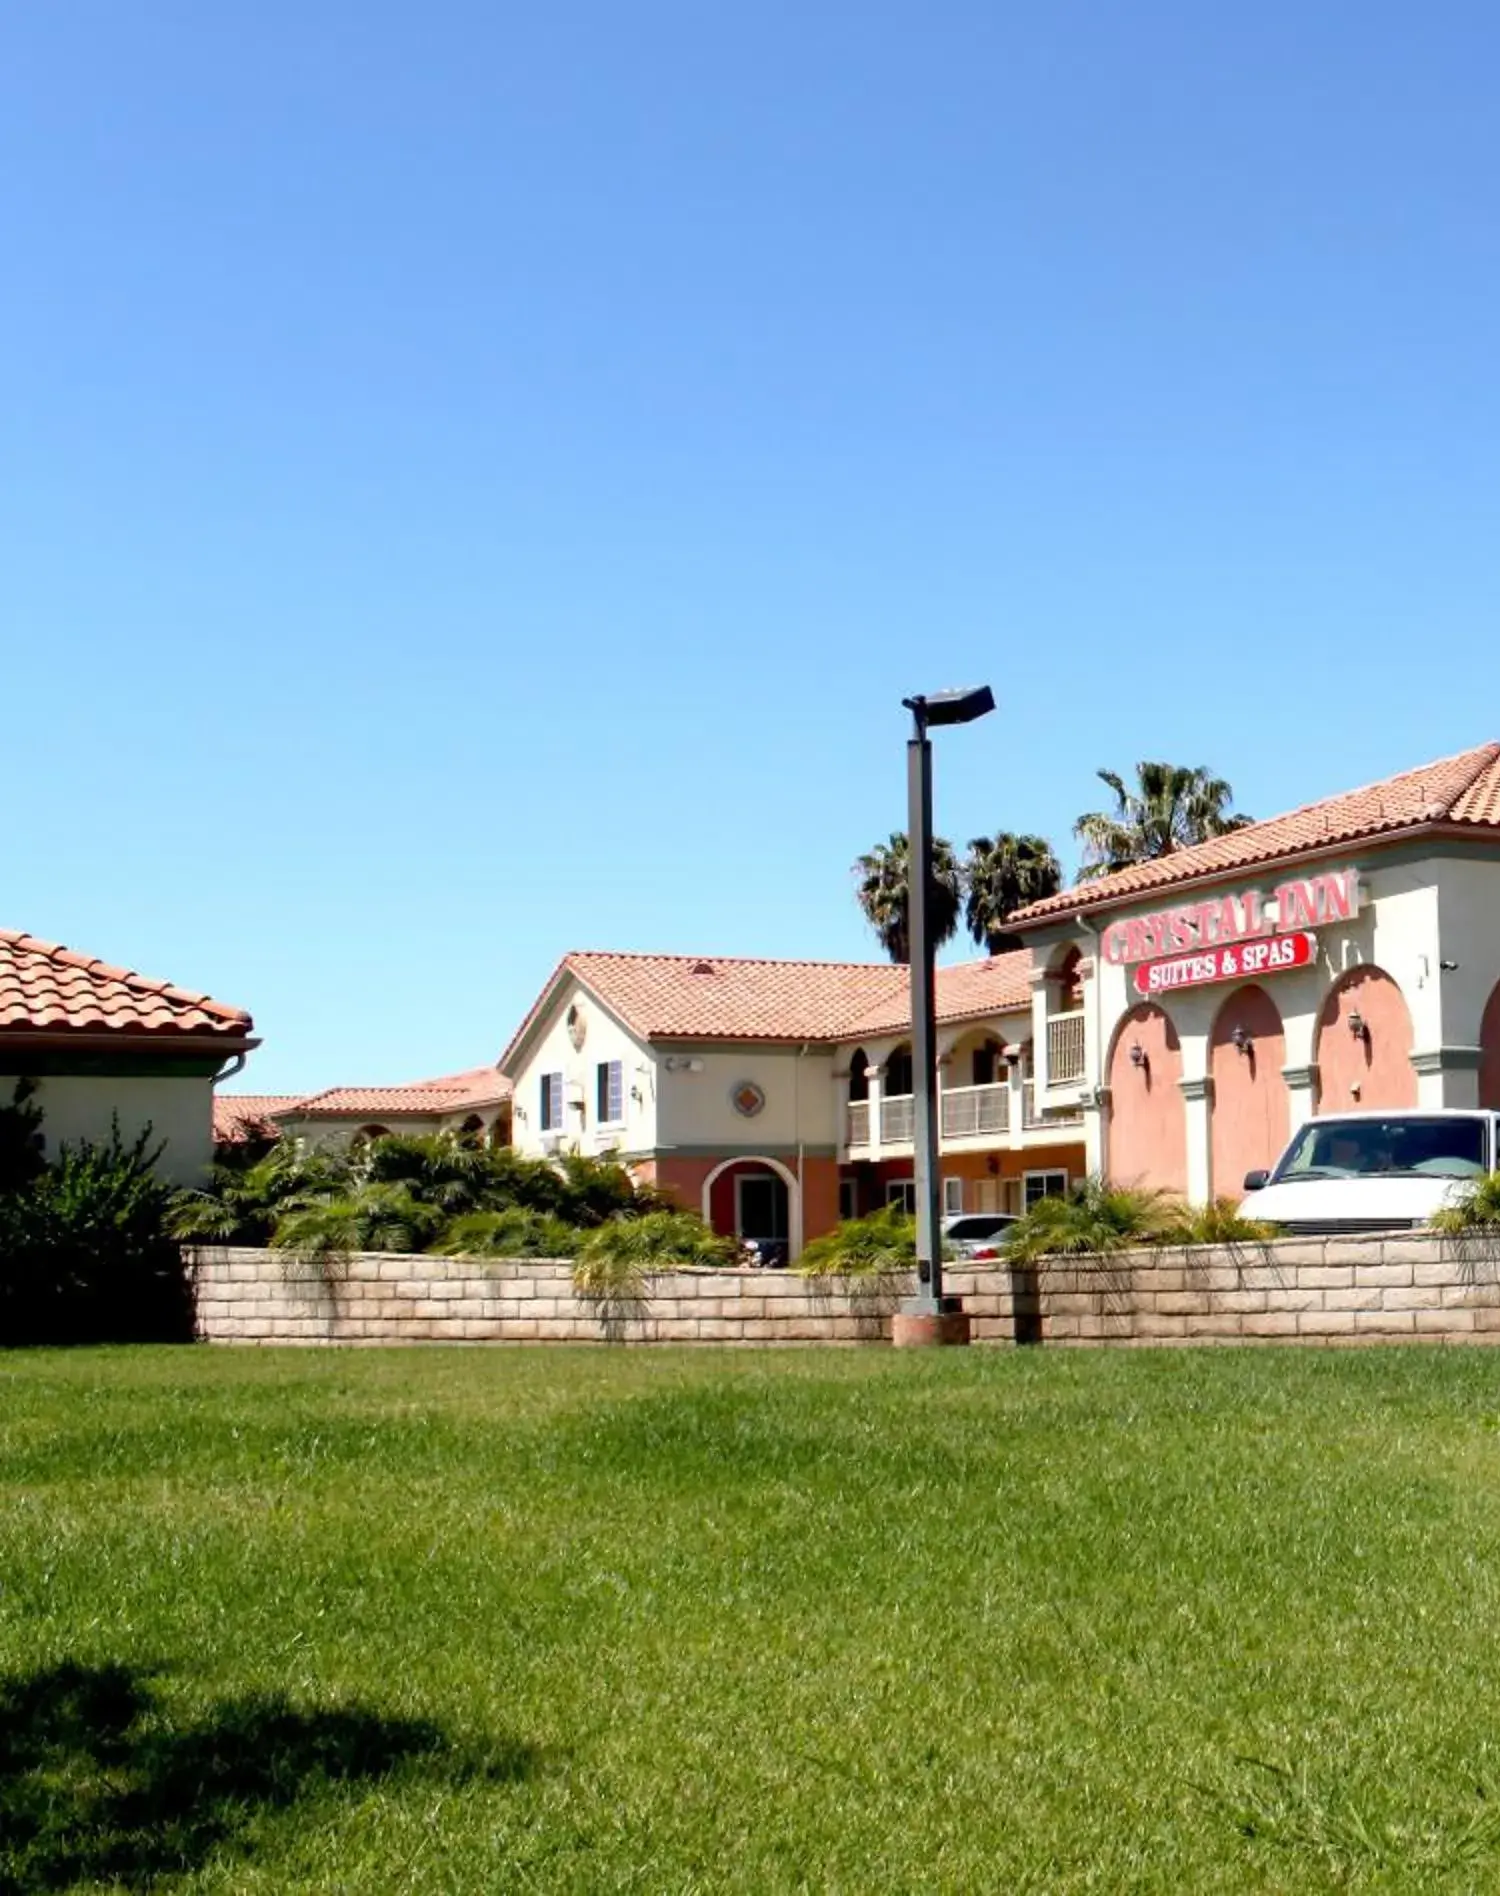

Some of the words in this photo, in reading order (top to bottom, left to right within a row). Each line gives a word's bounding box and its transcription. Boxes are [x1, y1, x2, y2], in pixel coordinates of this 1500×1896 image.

[1102, 890, 1272, 965] CRYSTAL
[1273, 868, 1360, 933] INN
[1148, 952, 1217, 989] SUITES
[1221, 950, 1238, 975] &
[1241, 938, 1296, 971] SPAS
